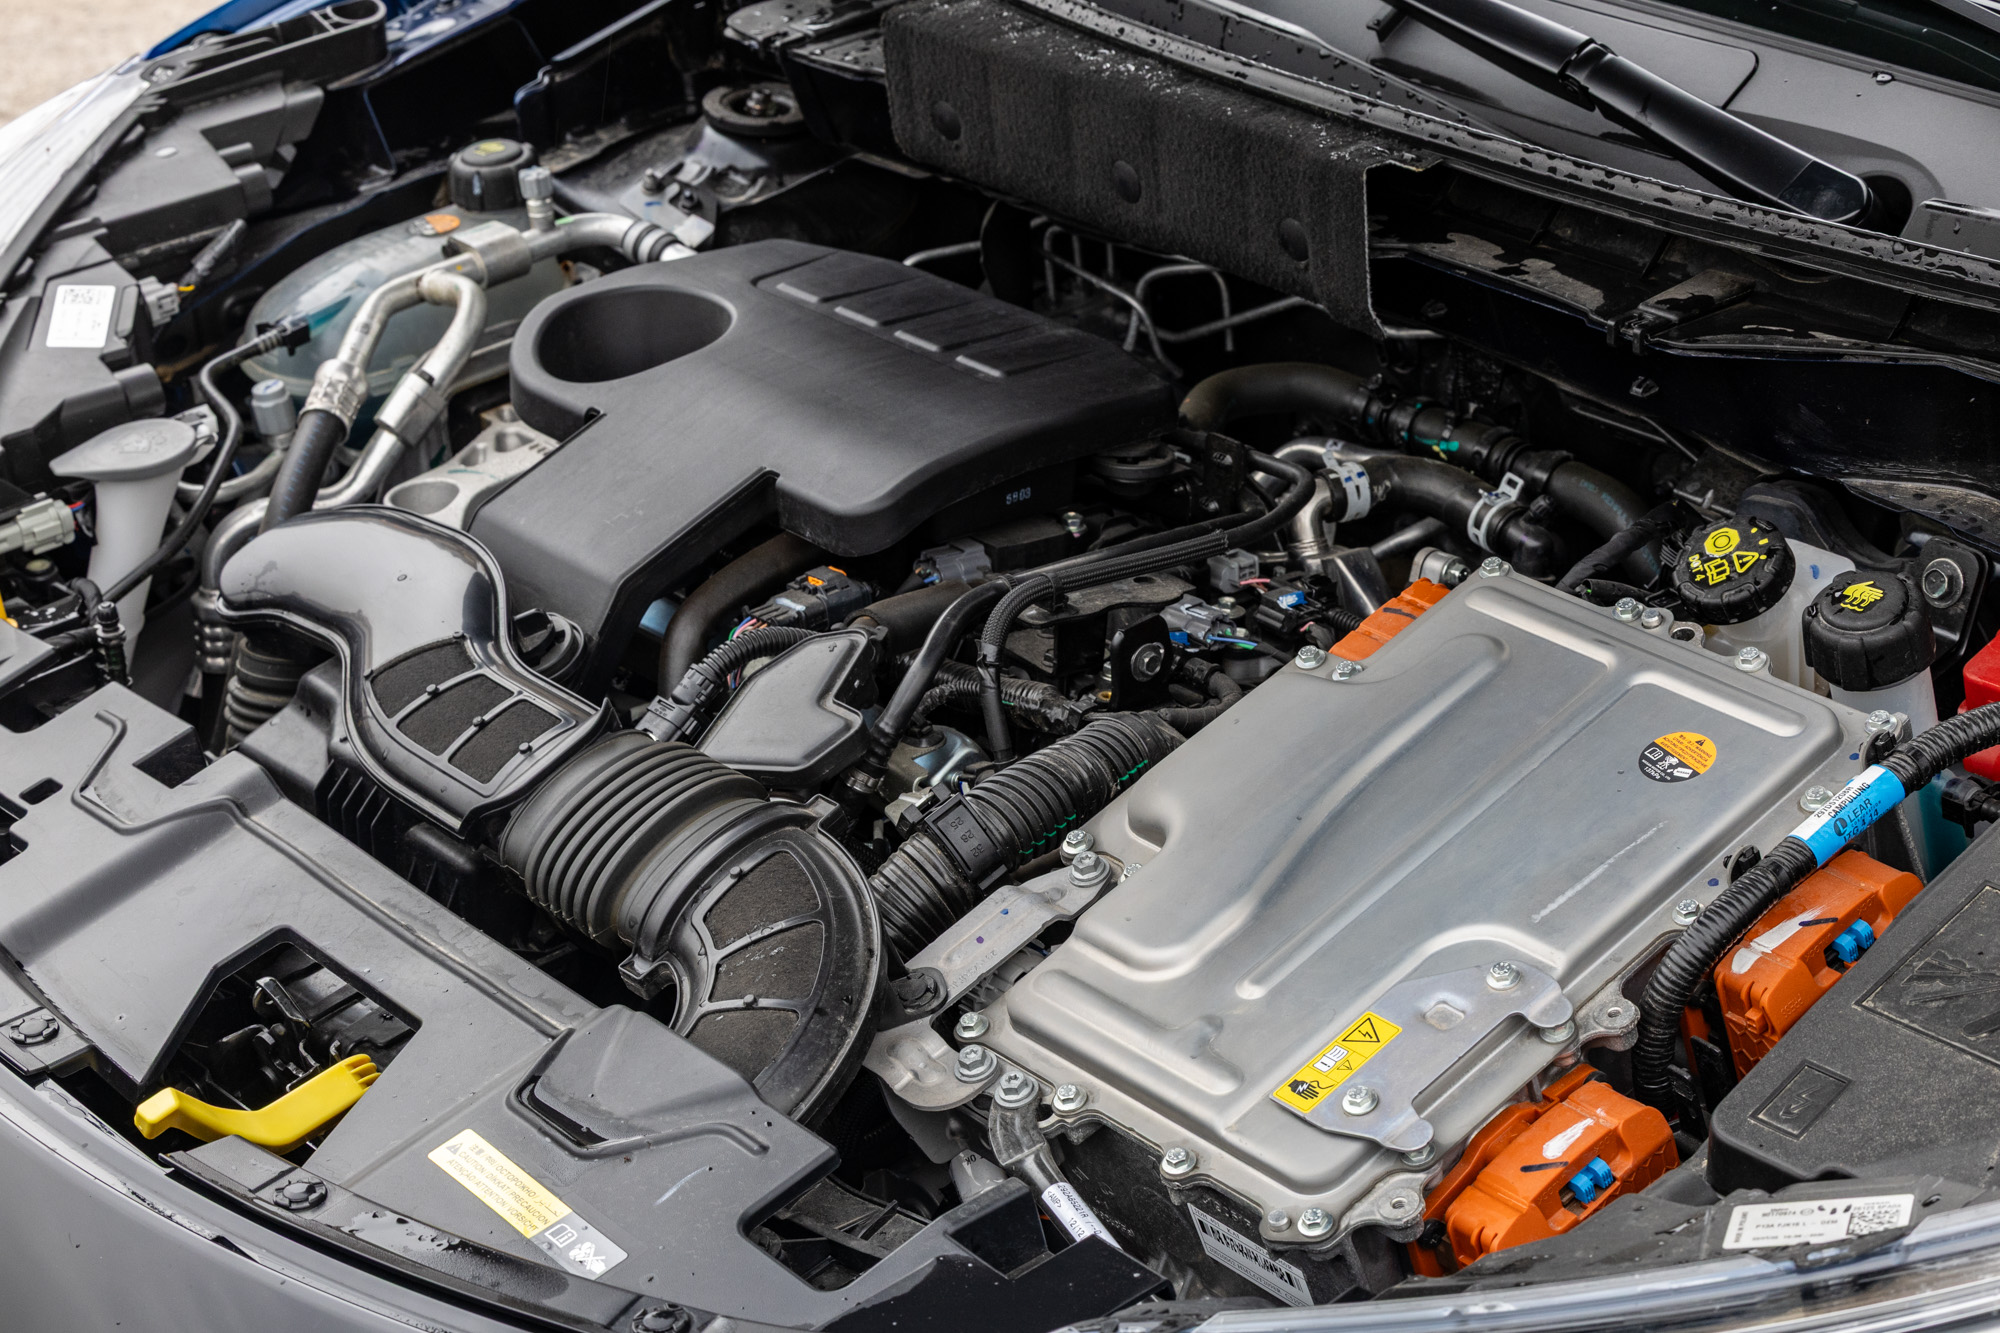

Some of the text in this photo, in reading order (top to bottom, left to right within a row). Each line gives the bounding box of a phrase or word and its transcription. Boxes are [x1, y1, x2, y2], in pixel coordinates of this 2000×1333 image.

[1689, 554, 1703, 572] DOT
[1828, 782, 1870, 818] CAMPULUNG
[1847, 798, 1872, 822] LEAR
[950, 816, 964, 829] 25
[960, 830, 975, 843] 28
[970, 843, 985, 858] 32
[458, 1151, 486, 1174] CAUTION
[964, 1154, 977, 1165] OK
[475, 1180, 508, 1207] ATTENTION
[506, 1206, 538, 1232] VORSICHT
